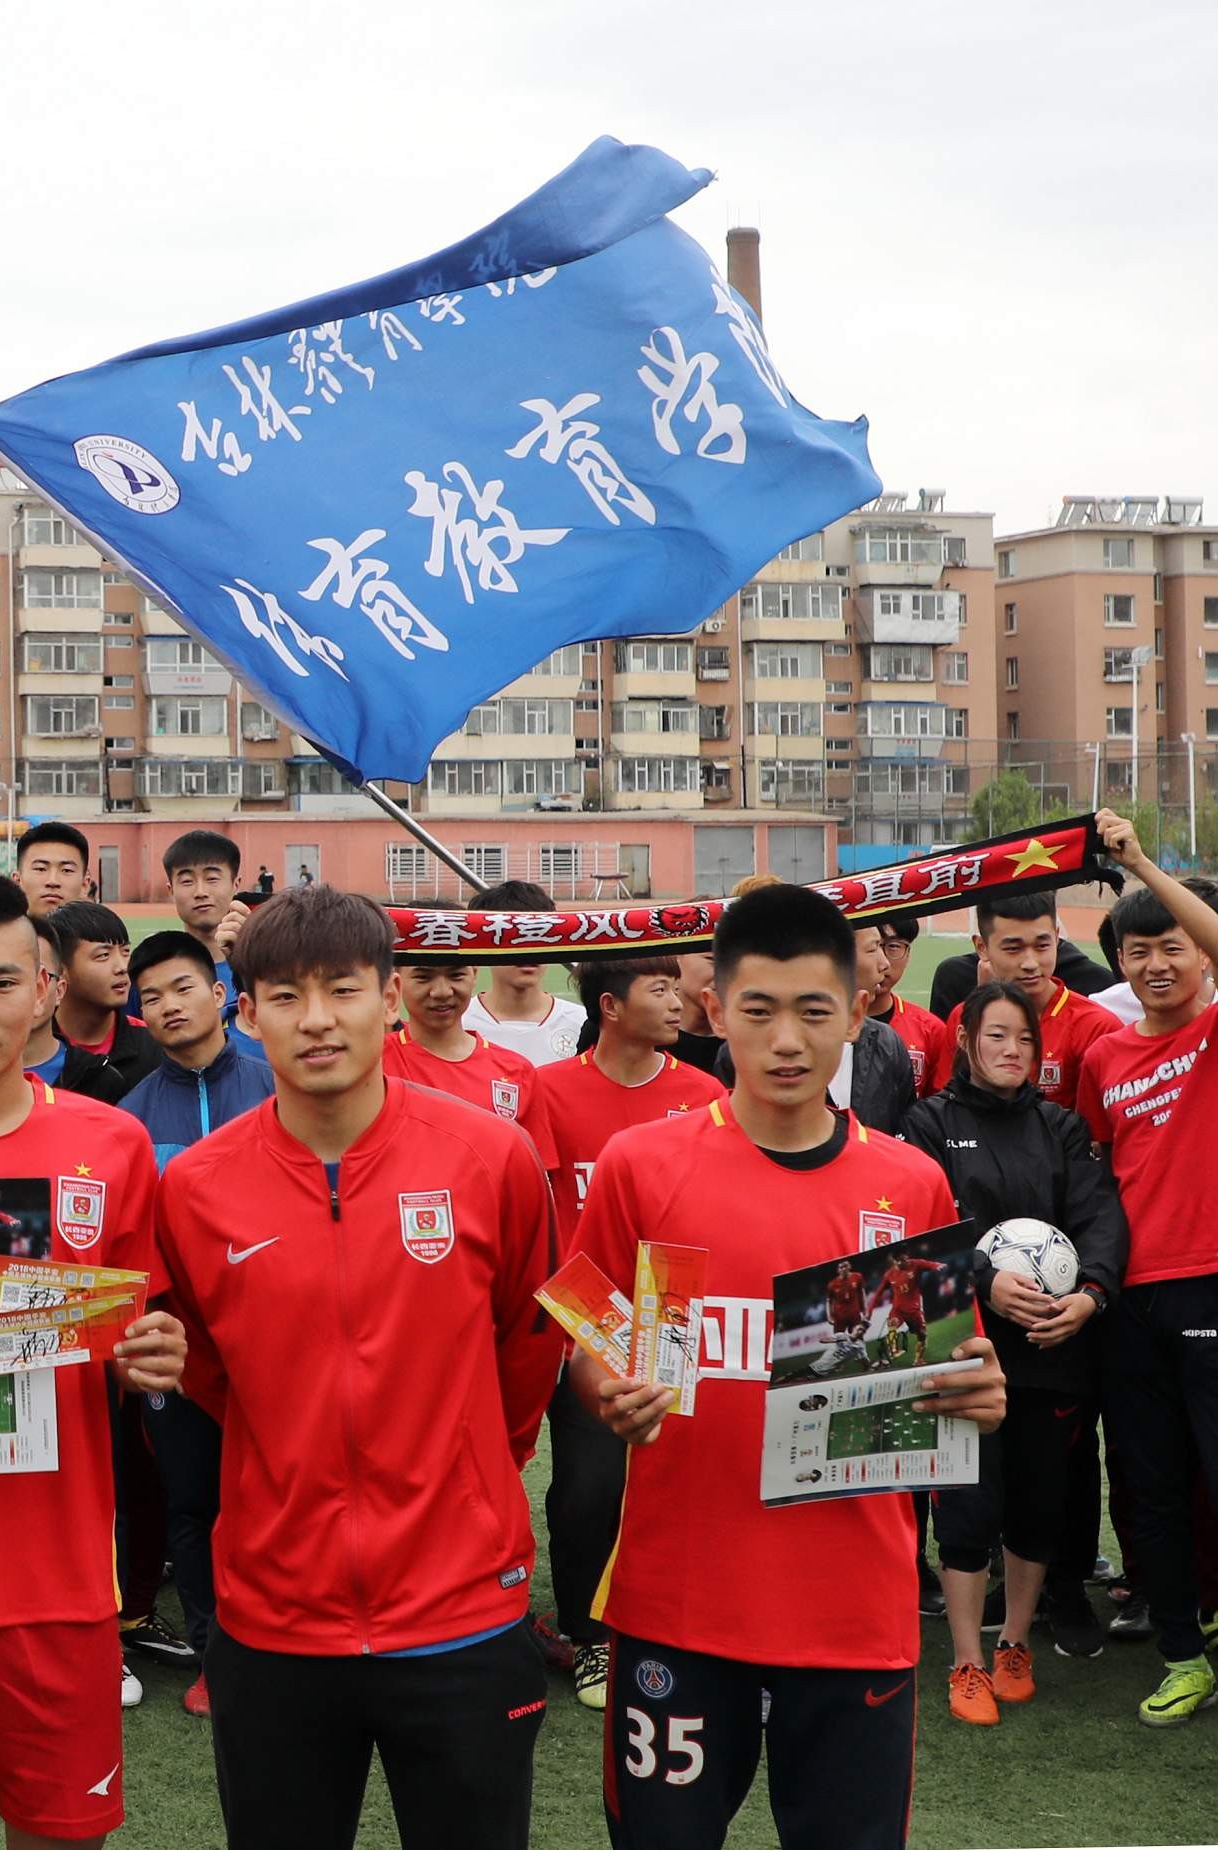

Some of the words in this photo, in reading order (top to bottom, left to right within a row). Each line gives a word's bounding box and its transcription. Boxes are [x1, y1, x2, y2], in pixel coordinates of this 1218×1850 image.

[394, 909, 645, 947] 春橙风
[625, 1706, 704, 1786] 35
